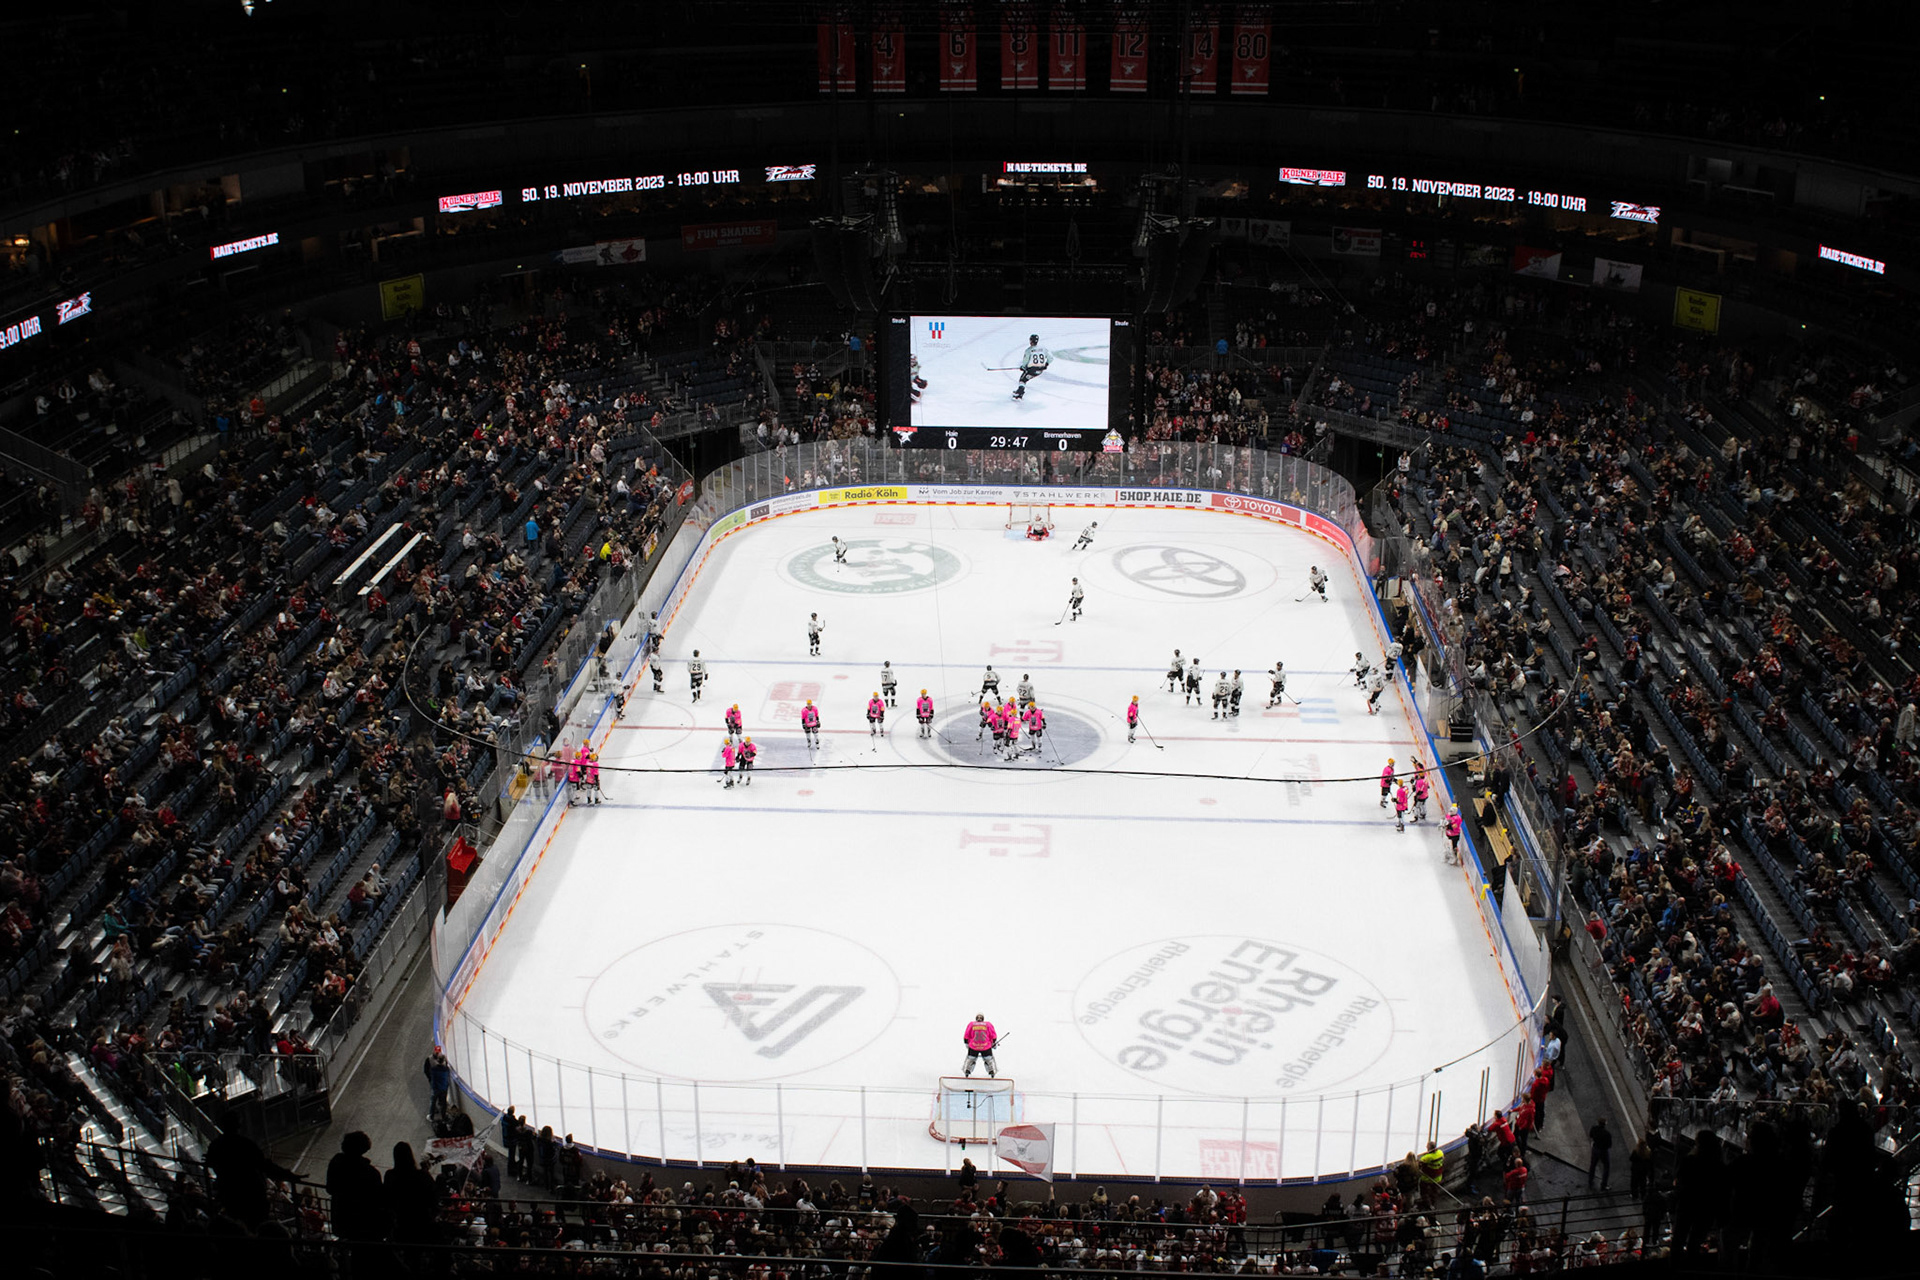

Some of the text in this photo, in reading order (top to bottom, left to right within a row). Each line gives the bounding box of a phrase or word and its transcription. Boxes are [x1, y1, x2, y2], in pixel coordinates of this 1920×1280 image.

[877, 33, 894, 59] 4
[949, 31, 967, 58] 6
[1009, 27, 1028, 55] 8
[1058, 33, 1081, 57] 11
[1117, 33, 1145, 58] 12
[1190, 33, 1215, 60] 14
[1236, 33, 1268, 60] 80
[1006, 162, 1088, 173] HAIE-TICKETS.DE
[1320, 171, 1343, 183] HAIE
[477, 191, 500, 204] HAIE
[522, 188, 541, 202] SO.
[544, 185, 561, 200] 19.
[563, 178, 633, 197] NOVEMBER
[635, 175, 665, 190] 2023
[677, 171, 710, 187] 19:00
[712, 169, 740, 184] UHR
[1367, 175, 1387, 189] SO.
[1391, 177, 1409, 191] 19.
[1412, 179, 1481, 199] NOVEMBER
[1484, 186, 1515, 202] 2023
[1528, 191, 1558, 208] 19:00
[1561, 195, 1587, 212] UHR
[696, 225, 762, 240] FUN SHARKS
[212, 232, 279, 259] HAIE-TICKETS.DE
[1820, 246, 1886, 274] HAIE-TICKETS.DE
[20, 316, 42, 339] UHR
[1033, 354, 1045, 364] 89
[948, 437, 958, 450] 0
[990, 436, 1029, 448] 29:47
[1058, 439, 1068, 451] 0
[845, 489, 873, 500] Radio
[876, 488, 899, 499] Köln
[932, 488, 949, 496] Vom
[949, 488, 962, 496] Job
[975, 488, 1003, 496] Karriere
[1023, 491, 1102, 499] STAHLWERK
[1120, 491, 1203, 504] SHOP.HAIE.DE
[1243, 499, 1283, 517] TOYOTA
[1080, 940, 1191, 1026] RheinEnergie
[1118, 940, 1299, 1072] Energie
[1189, 966, 1339, 1066] Rhein
[1276, 995, 1380, 1089] RheinEnergie
